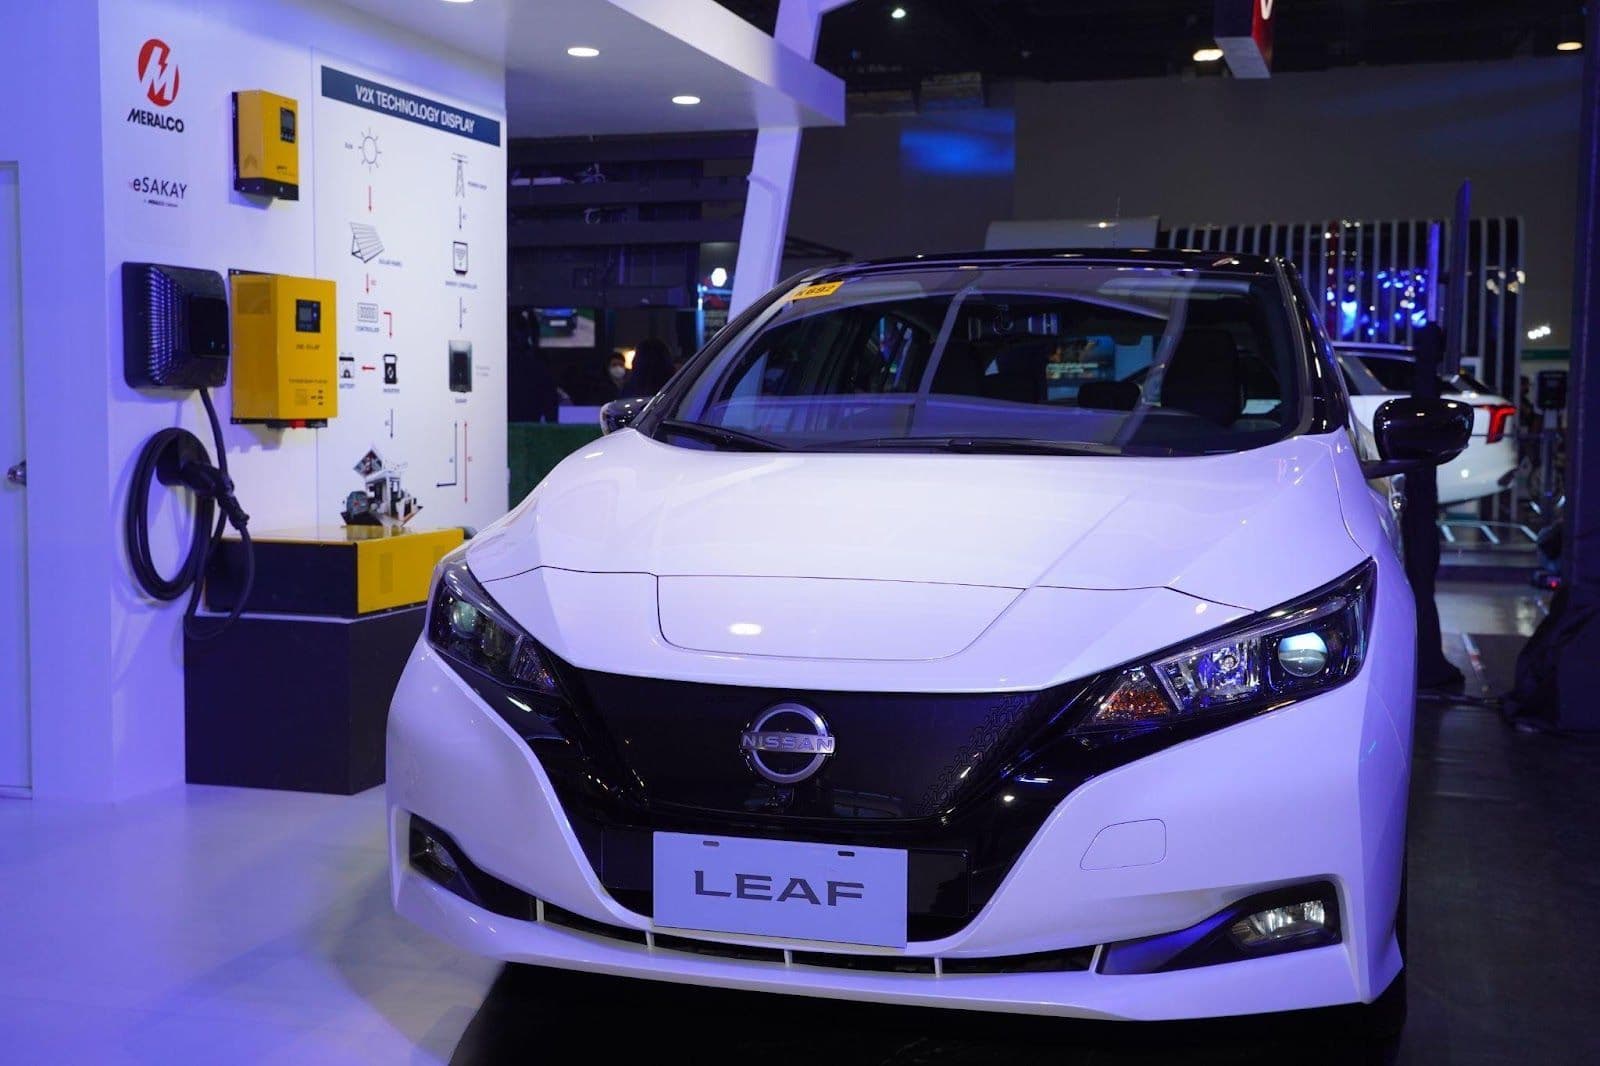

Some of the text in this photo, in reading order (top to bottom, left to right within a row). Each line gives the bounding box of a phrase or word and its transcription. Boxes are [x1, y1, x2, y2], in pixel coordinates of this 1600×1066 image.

[127, 108, 185, 133] MERALCO
[355, 84, 476, 135] V2X TECHNOLOGY DISPLAY
[133, 176, 188, 199] eSAKAY
[742, 734, 833, 752] NISSAN
[693, 869, 866, 907] LEAF
